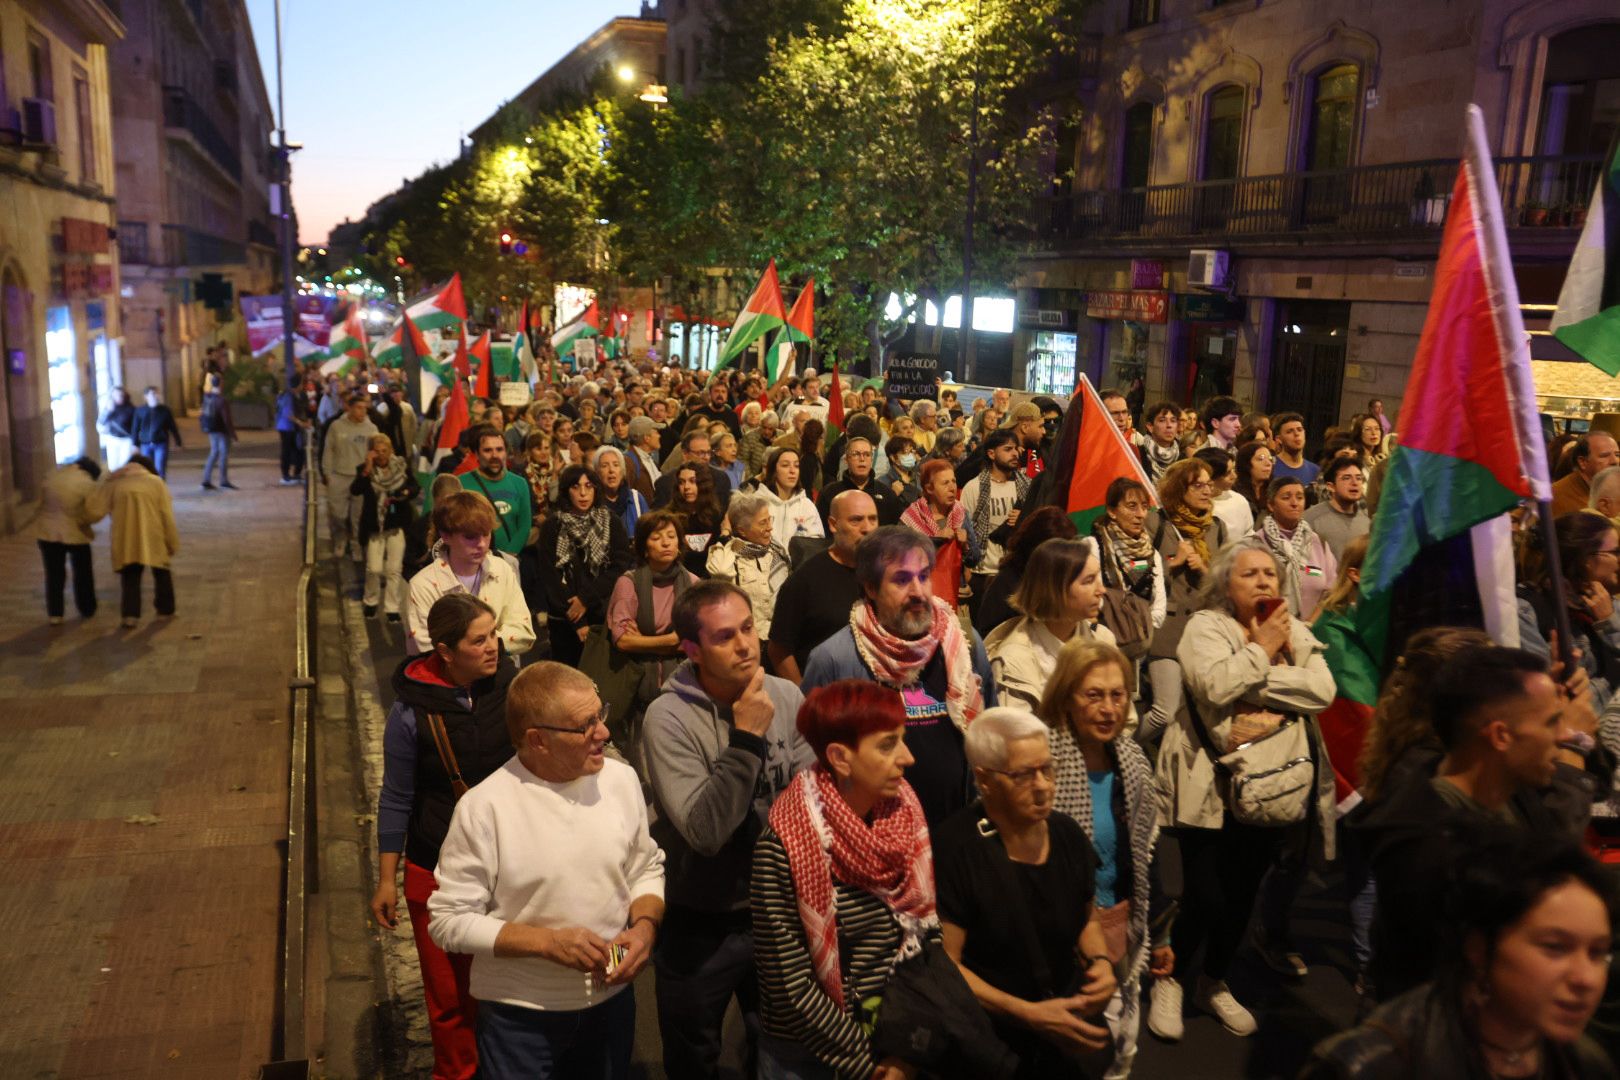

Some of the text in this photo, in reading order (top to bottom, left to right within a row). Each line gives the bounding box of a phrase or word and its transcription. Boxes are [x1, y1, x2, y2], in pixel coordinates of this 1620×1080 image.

[1088, 292, 1114, 307] BAZAR
[912, 371, 922, 381] LA
[889, 384, 935, 395] COMPLICIDAD
[920, 702, 947, 715] HAR
